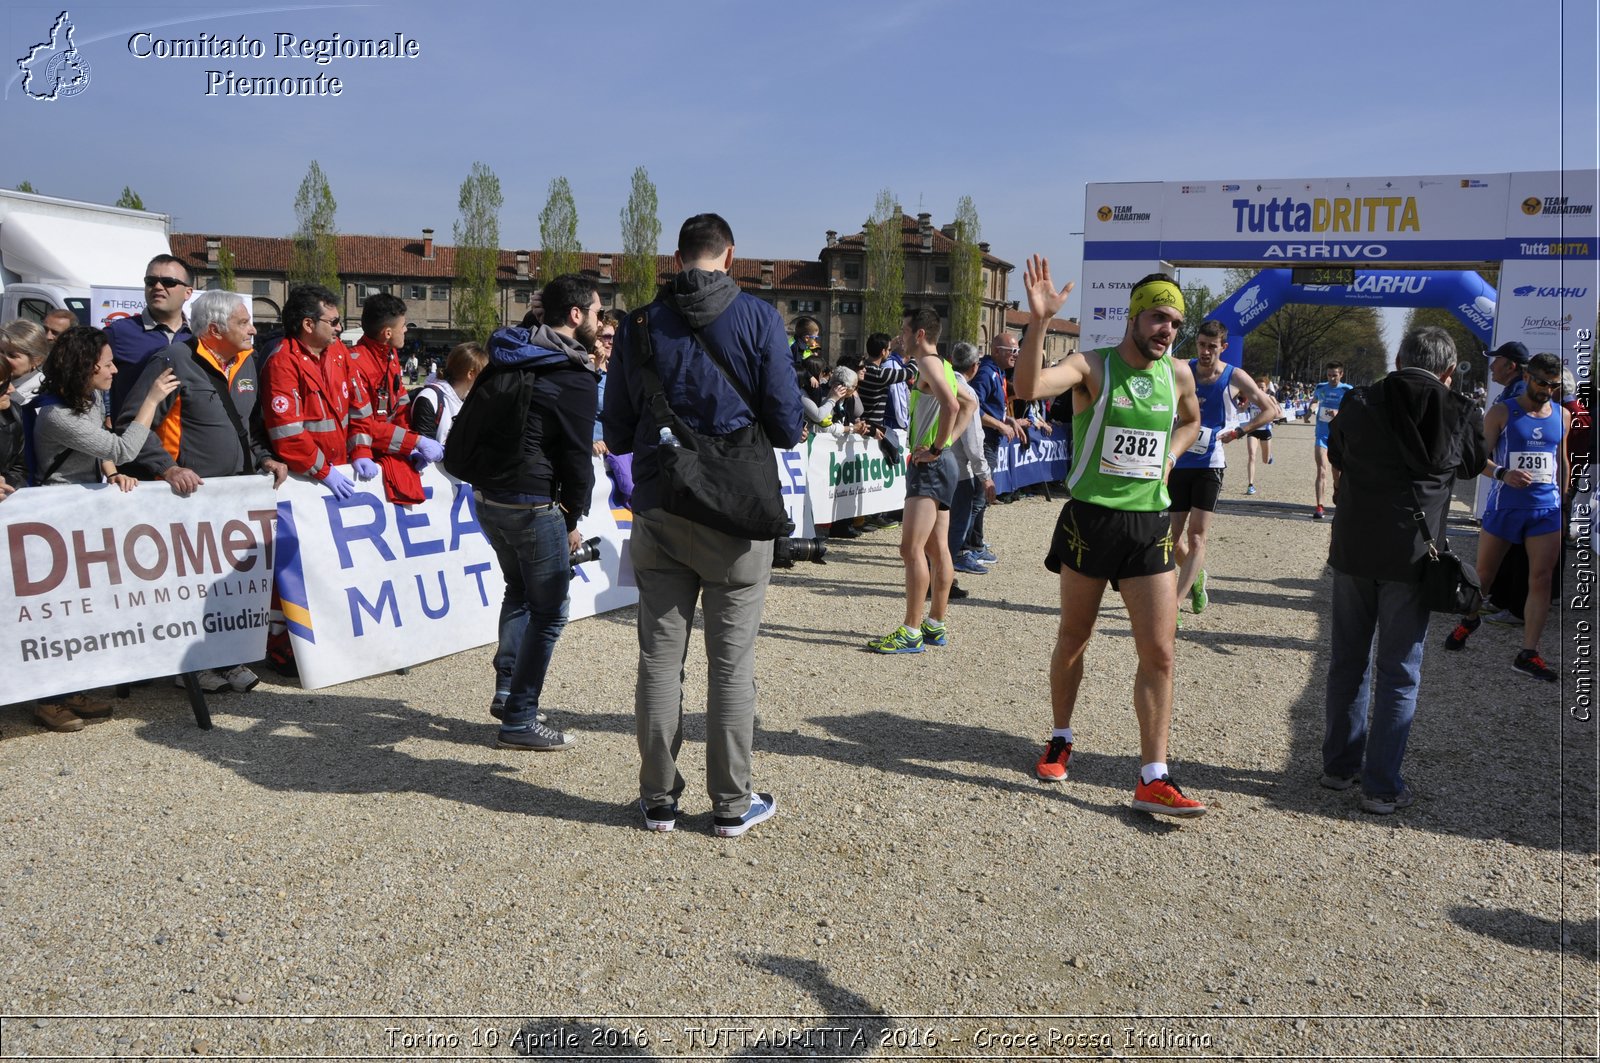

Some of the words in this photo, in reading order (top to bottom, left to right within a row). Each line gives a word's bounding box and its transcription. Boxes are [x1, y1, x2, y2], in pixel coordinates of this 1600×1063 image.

[1541, 205, 1593, 215] MARATHON
[1543, 197, 1569, 206] TEAM
[1112, 213, 1151, 221] MARATHON
[1232, 196, 1421, 233] TuttaDRITTA
[1262, 243, 1388, 259] ARRIVO
[1346, 275, 1427, 294] KARHU
[1536, 287, 1588, 298] KARHU
[1109, 307, 1130, 316] REA
[1239, 298, 1270, 327] KARHU
[1458, 303, 1492, 331] KARHU
[1113, 434, 1158, 458] 2382
[1518, 456, 1547, 469] 2391
[321, 482, 491, 570] REA
[18, 597, 94, 623] ASTE
[344, 561, 492, 638] MUT
[20, 622, 147, 662] Risparmi
[152, 617, 198, 641] con
[202, 607, 270, 634] Giudizio
